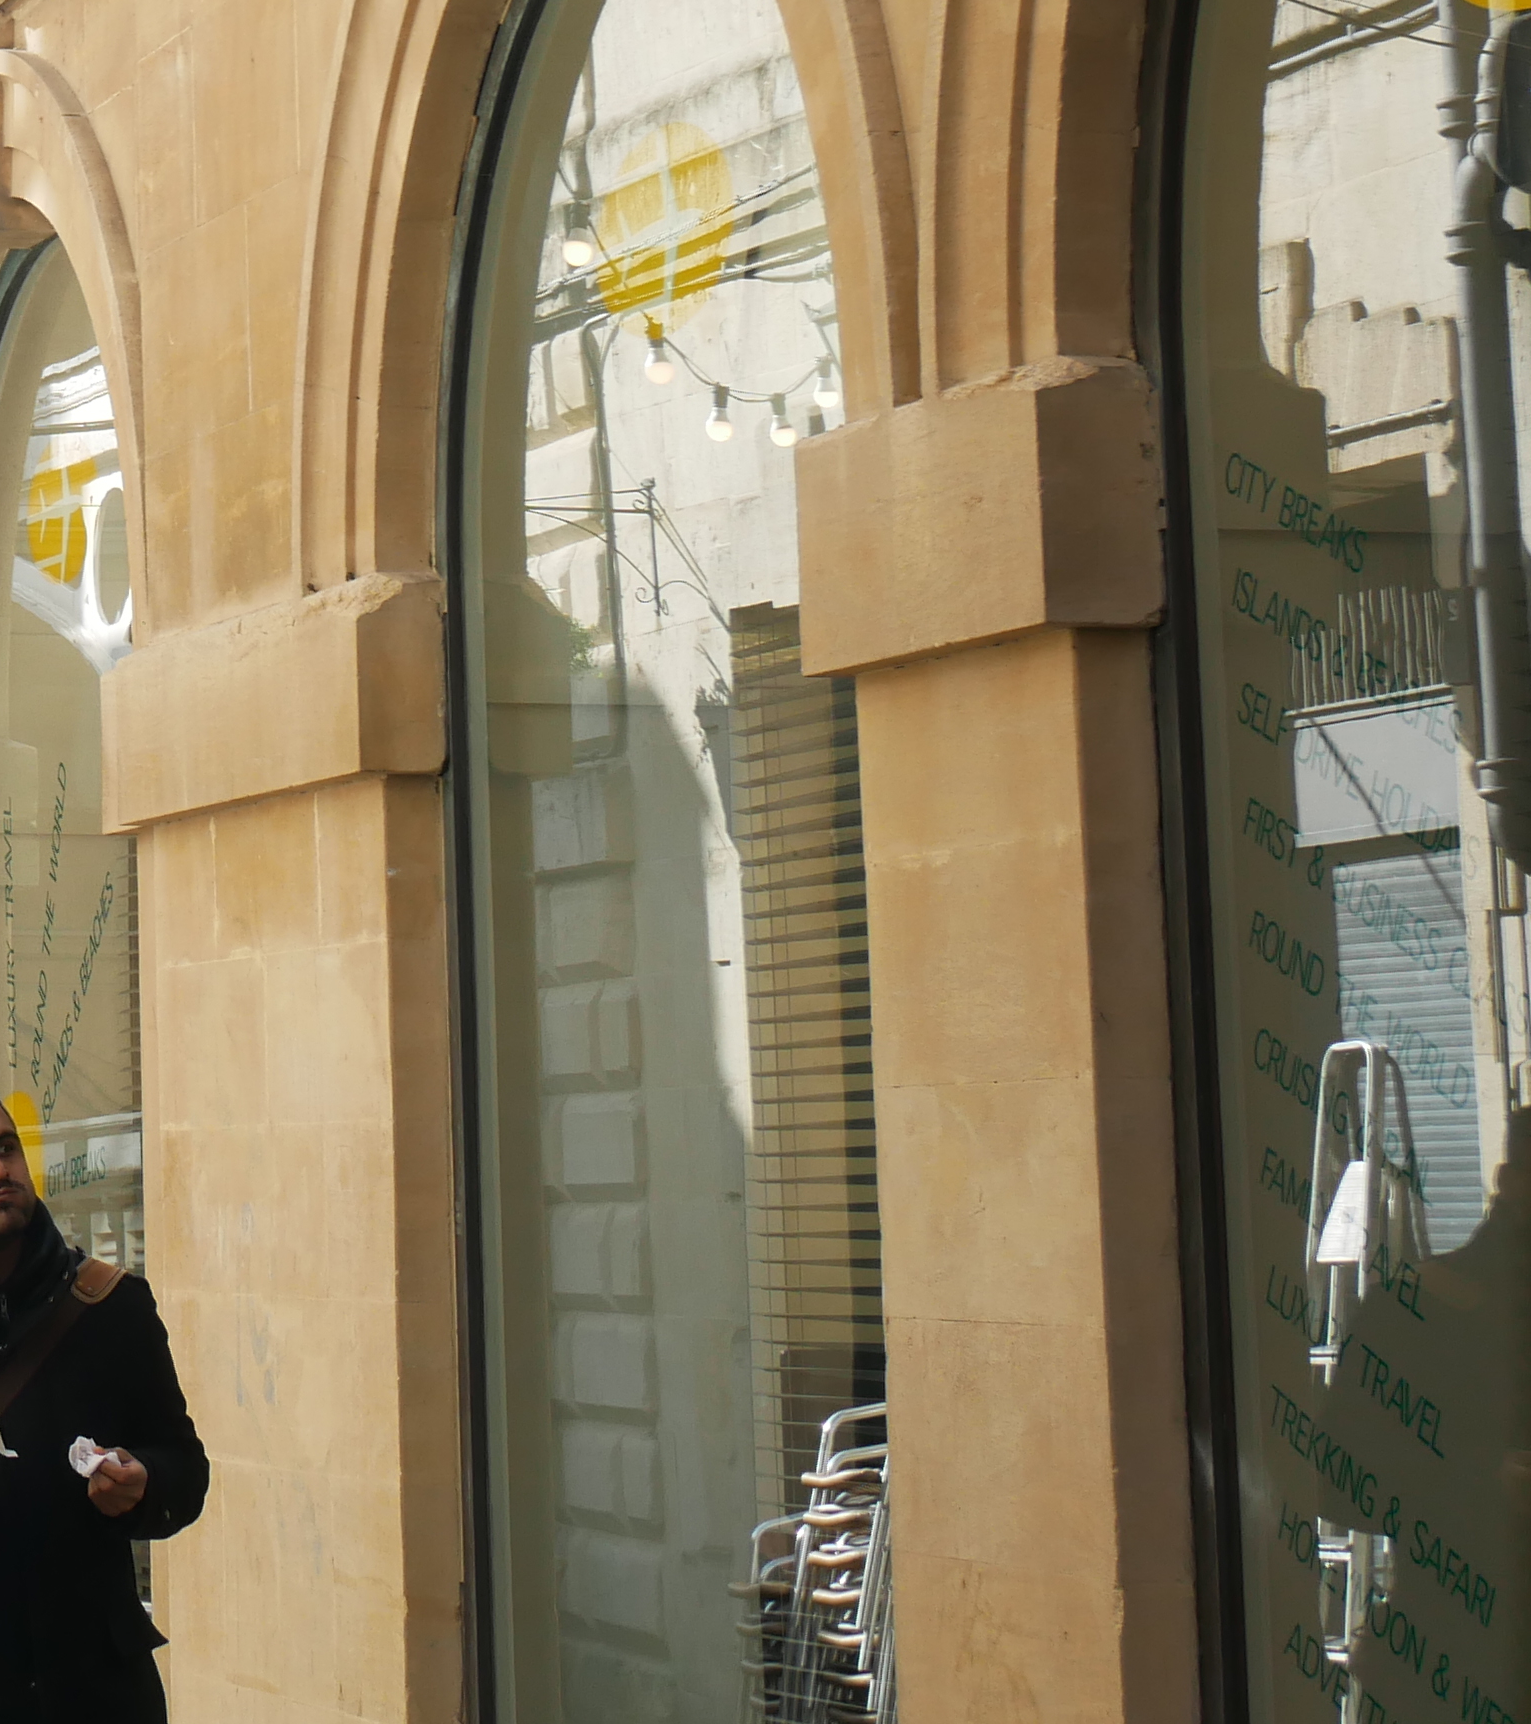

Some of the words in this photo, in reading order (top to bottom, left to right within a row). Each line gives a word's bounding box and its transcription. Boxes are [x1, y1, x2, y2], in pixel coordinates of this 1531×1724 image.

[1225, 452, 1276, 513] CITY
[1278, 485, 1369, 574] BREAKS
[1232, 568, 1326, 663] ISLANDS
[1237, 681, 1291, 746] SELF
[2, 796, 15, 926] TRAVEL
[1243, 796, 1302, 869] FIRST
[1306, 844, 1325, 891] &
[1333, 862, 1441, 972] BUSINESS
[30, 968, 48, 1088] ROUND
[42, 890, 56, 956] THE
[49, 762, 68, 882] WORLD
[6, 939, 18, 1069] LUXURY
[1248, 910, 1325, 998] ROUND
[1388, 1010, 1470, 1109] WORLD
[47, 1159, 70, 1198] CITY
[70, 1145, 108, 1190] BREAKS
[1360, 1342, 1445, 1460] TRAVEL
[1271, 1382, 1378, 1519] TREKKING
[1382, 1495, 1401, 1544] &
[1409, 1519, 1497, 1629] SAFARI
[1431, 1653, 1451, 1702] &
